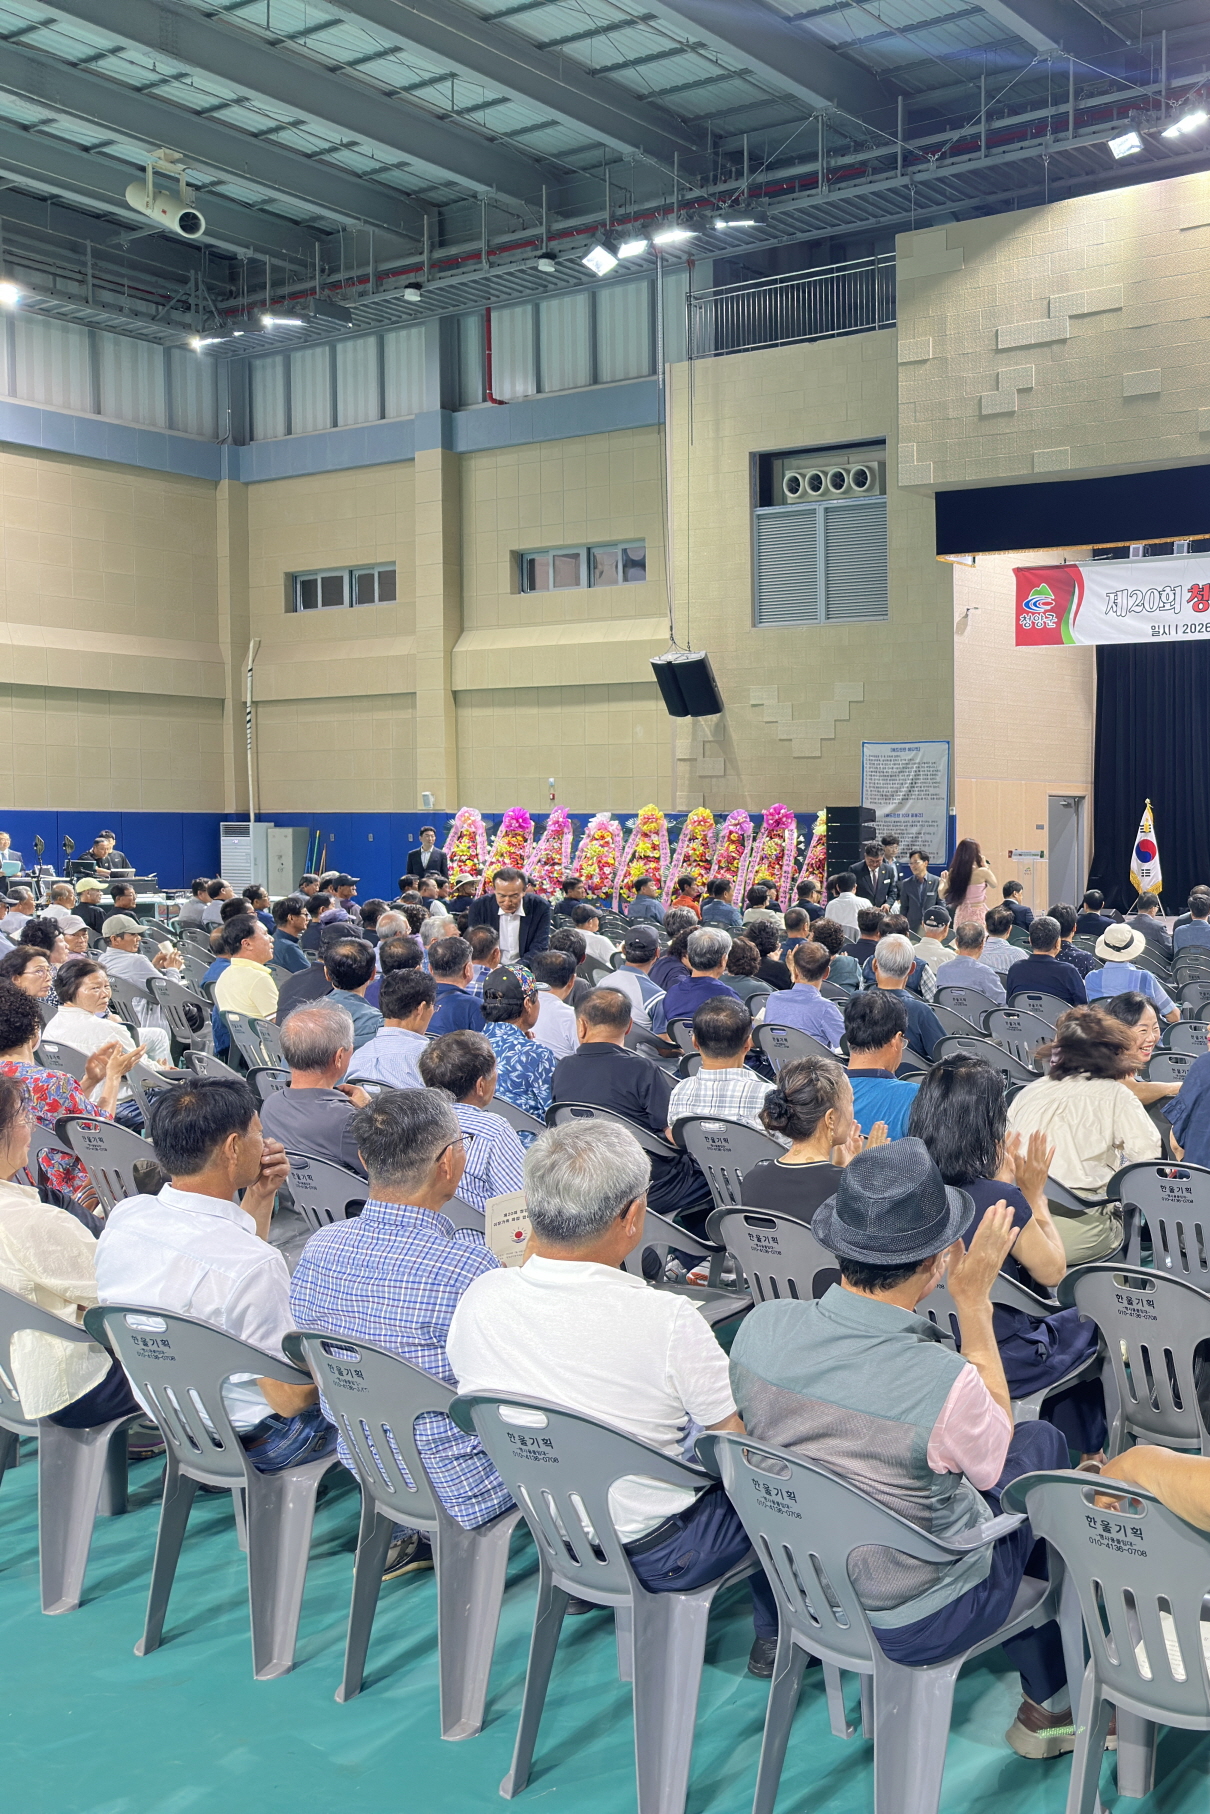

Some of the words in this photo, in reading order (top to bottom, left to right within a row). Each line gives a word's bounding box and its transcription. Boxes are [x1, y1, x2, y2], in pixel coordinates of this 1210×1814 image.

[1105, 585, 1183, 617] 제20회
[1020, 613, 1057, 629] 청양군
[1150, 624, 1171, 637] 일시
[1160, 1184, 1192, 1194] 한울기획
[1115, 1294, 1155, 1309] 한울기획
[507, 1432, 554, 1449] 한울기획
[751, 1478, 797, 1503] 한울기획
[1085, 1515, 1143, 1540] 한울기획
[1089, 1536, 1147, 1557] 010-4136-0708
